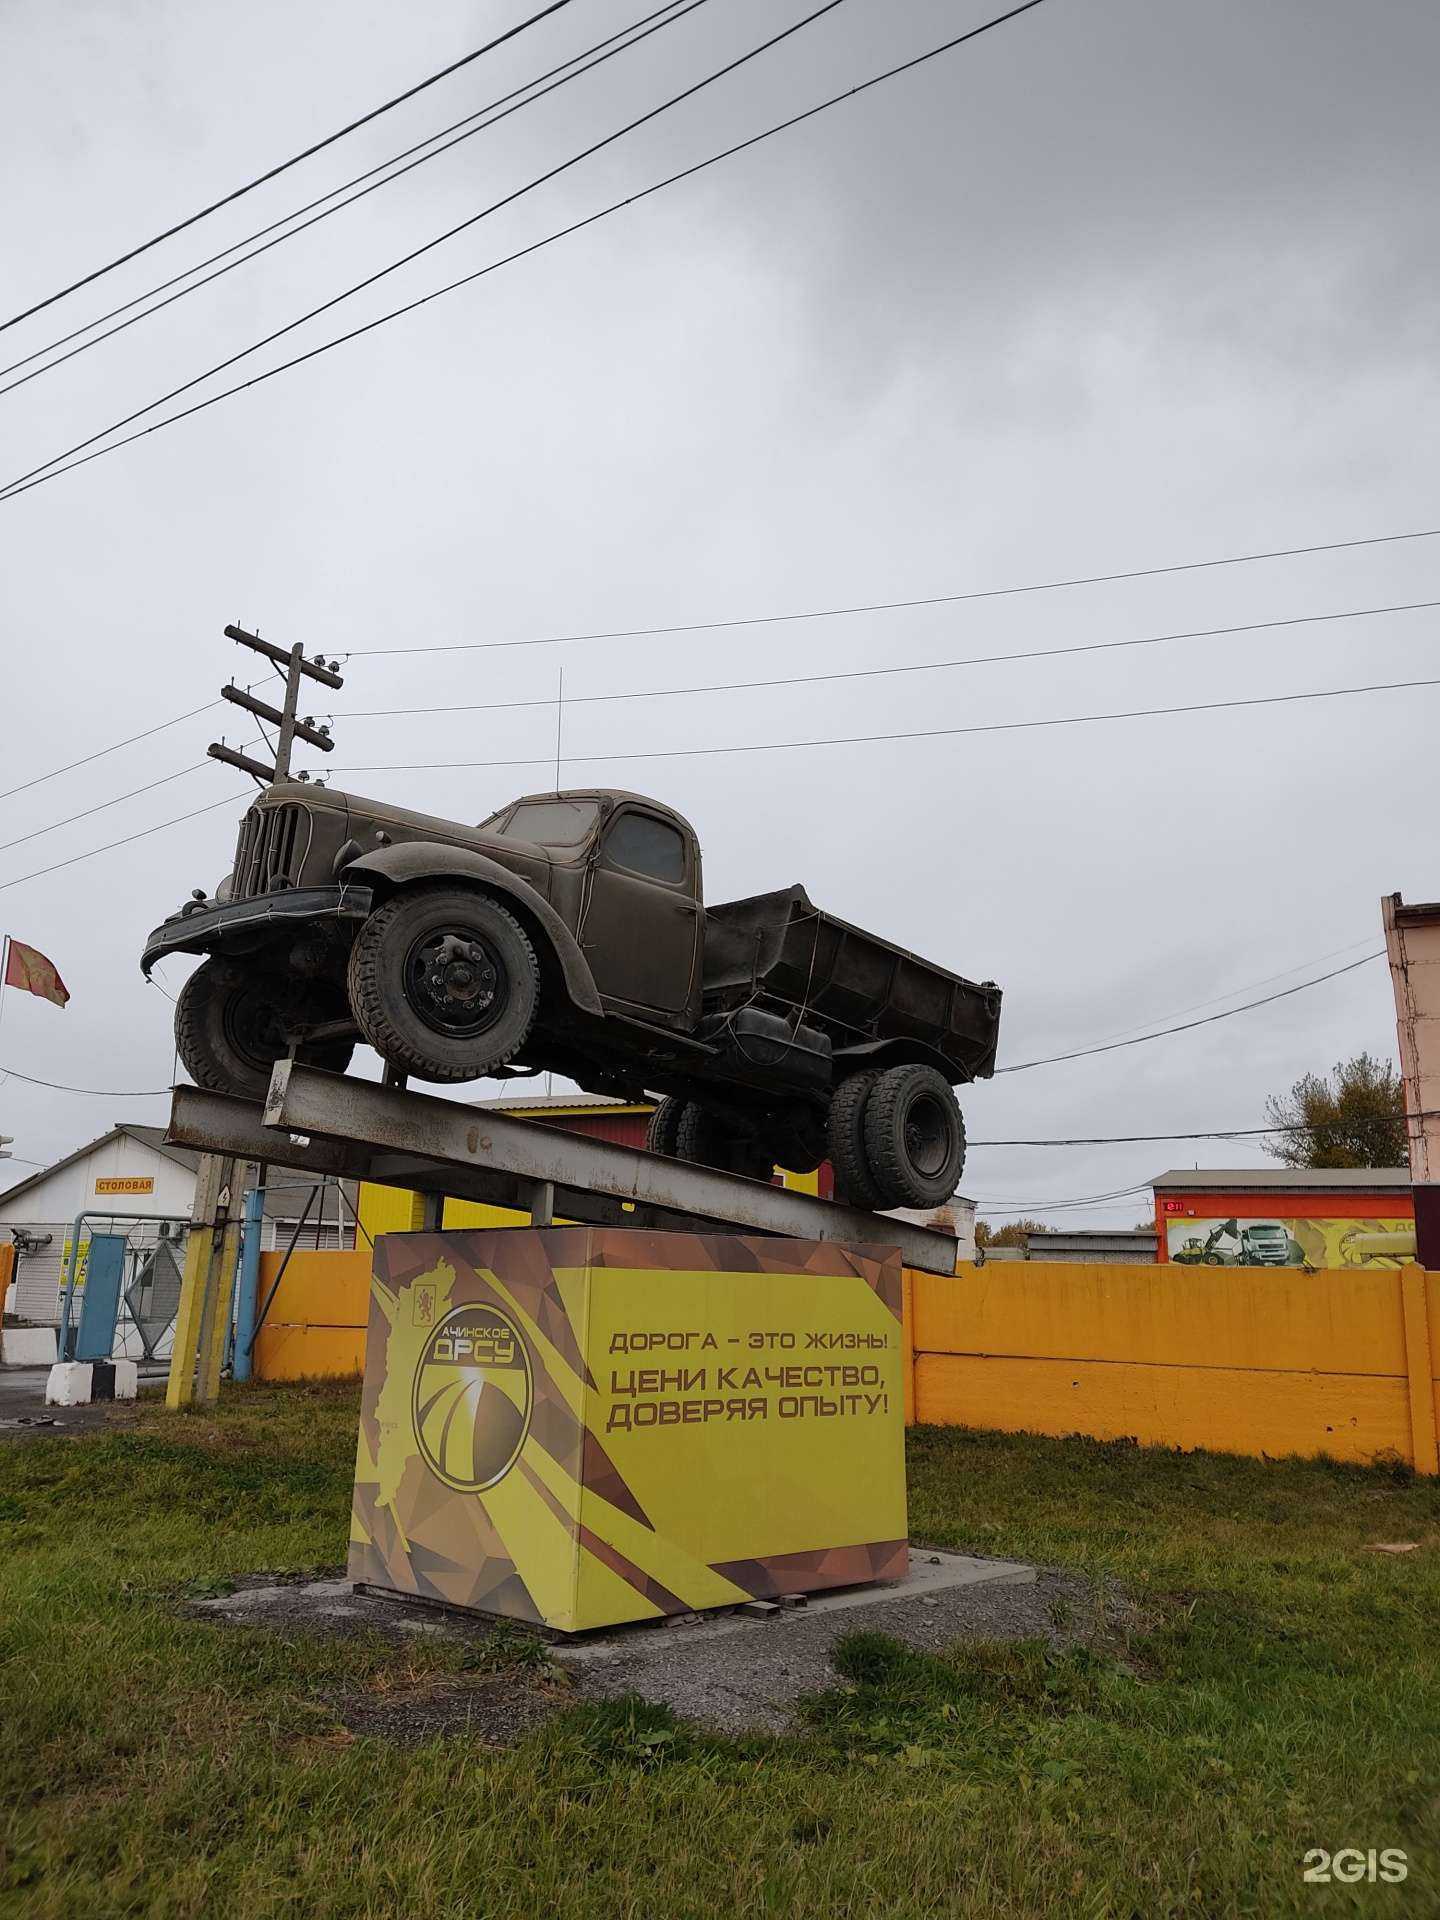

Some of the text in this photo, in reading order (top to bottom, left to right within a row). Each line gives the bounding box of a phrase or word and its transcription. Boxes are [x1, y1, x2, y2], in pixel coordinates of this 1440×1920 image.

[98, 1180, 152, 1191] СТОЛОВАЯ
[442, 1326, 510, 1339] АЧИНСКОЕ
[609, 1333, 718, 1354] ДОРОГА
[748, 1333, 796, 1350] ЭТО
[804, 1333, 888, 1350] ЖИЗНЬ!
[433, 1338, 515, 1363] ДРСУ
[611, 1365, 885, 1398] ЦЕНИ КАЧЕСТВО,
[606, 1394, 889, 1433] ДОВЕРЯЯ ОПЫТУ!
